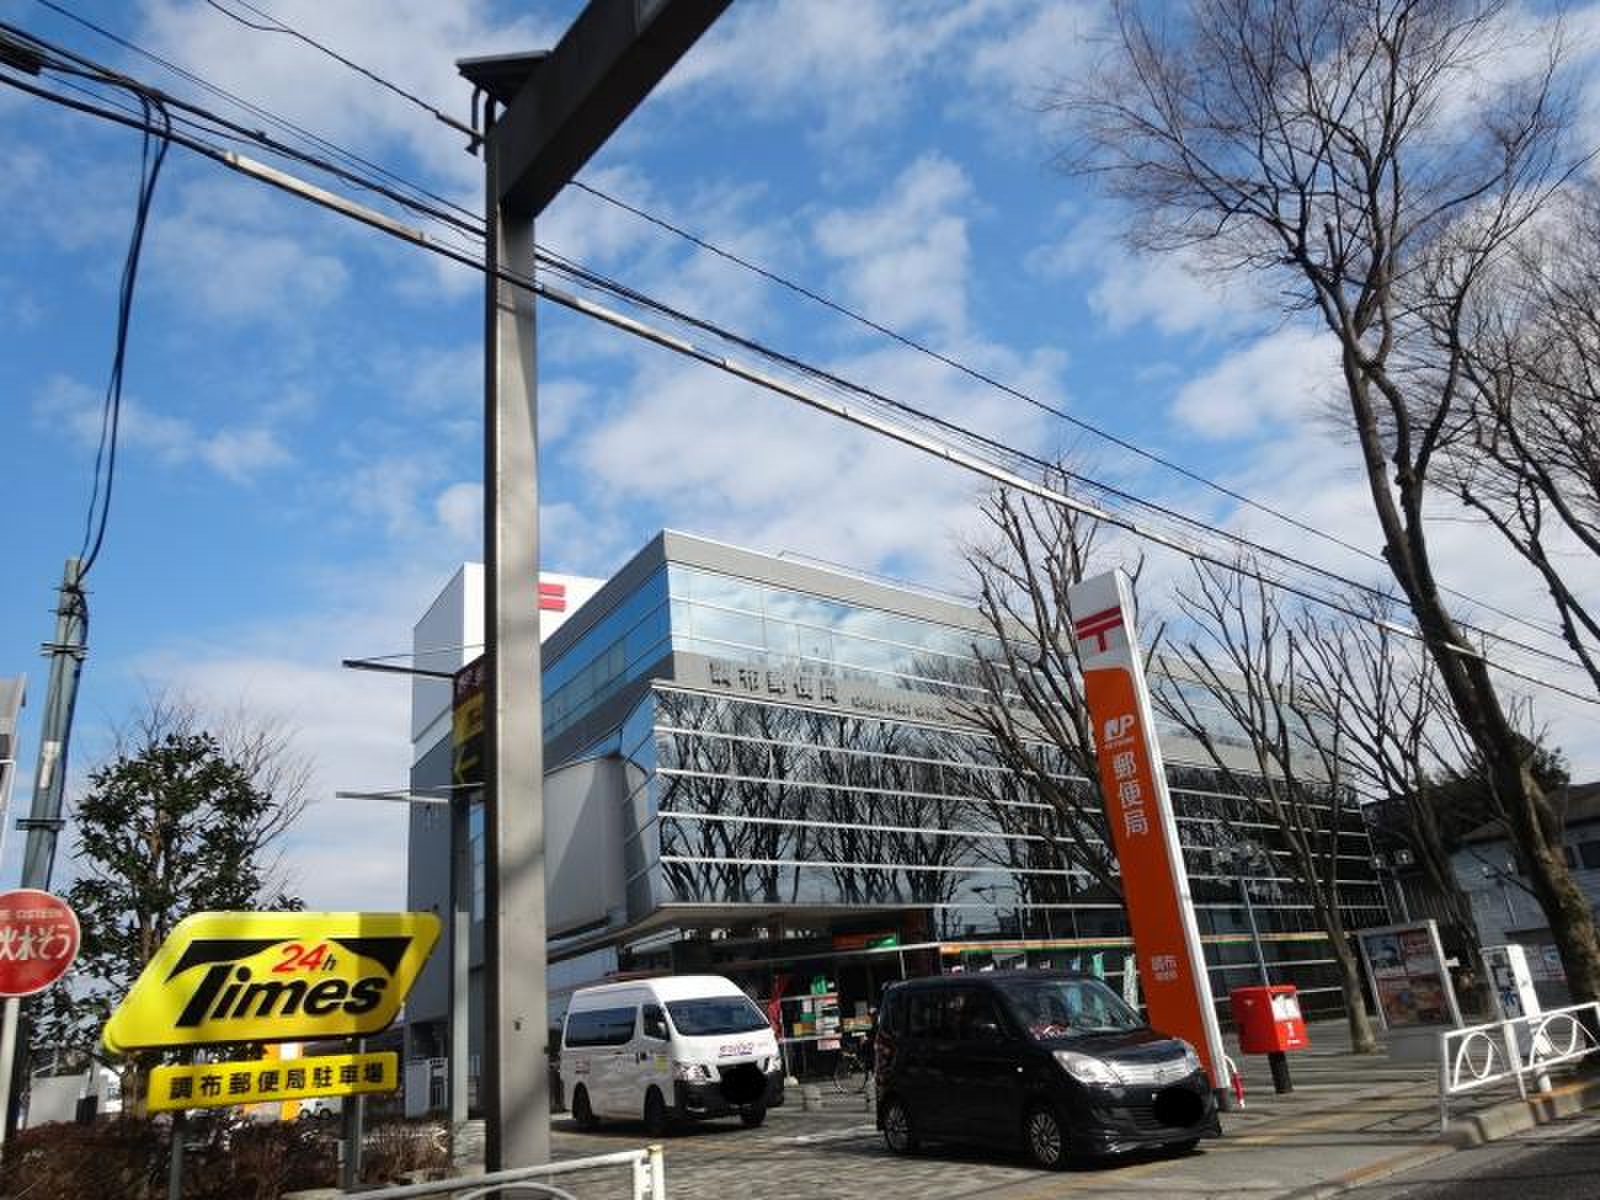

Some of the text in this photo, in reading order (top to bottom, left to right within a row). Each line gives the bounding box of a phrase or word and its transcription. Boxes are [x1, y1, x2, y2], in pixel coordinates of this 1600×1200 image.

[1113, 751, 1149, 838] 郵便局
[271, 943, 337, 973] 24h
[174, 961, 388, 1028] Times
[168, 1061, 384, 1100] 調布郵便局駐車場
